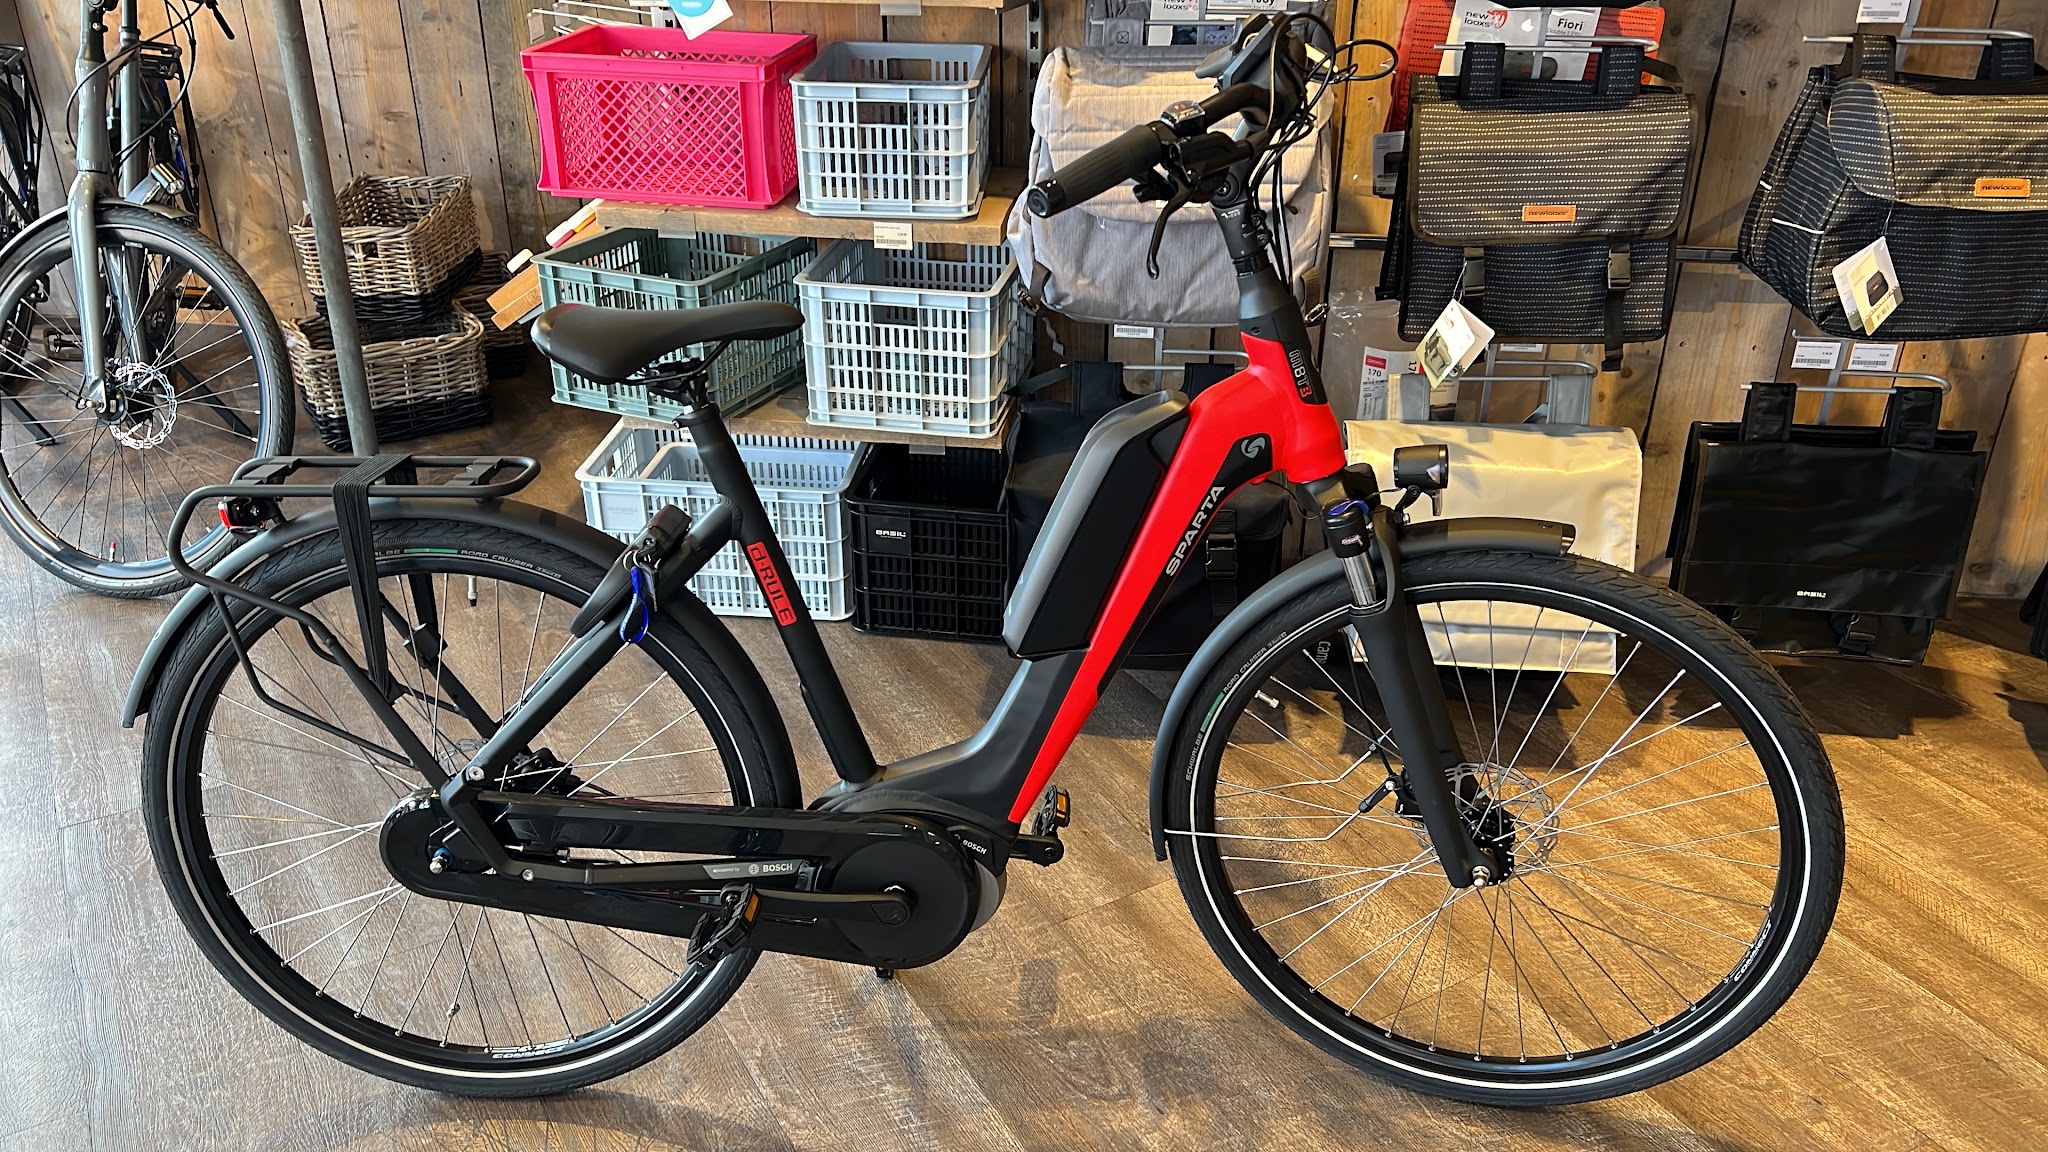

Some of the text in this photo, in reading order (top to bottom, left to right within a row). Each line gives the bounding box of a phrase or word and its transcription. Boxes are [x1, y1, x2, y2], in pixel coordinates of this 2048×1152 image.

[1465, 11, 1489, 20] new
[1557, 18, 1584, 31] Fiori
[1367, 367, 1382, 377] 170
[1165, 486, 1226, 577] SPARTA
[460, 549, 534, 569] ROAD CRUISER
[750, 547, 794, 622] d-RULE
[1185, 732, 1204, 782] SCHWALBE
[963, 839, 988, 855] BOSCH
[762, 863, 793, 873] BOSCH
